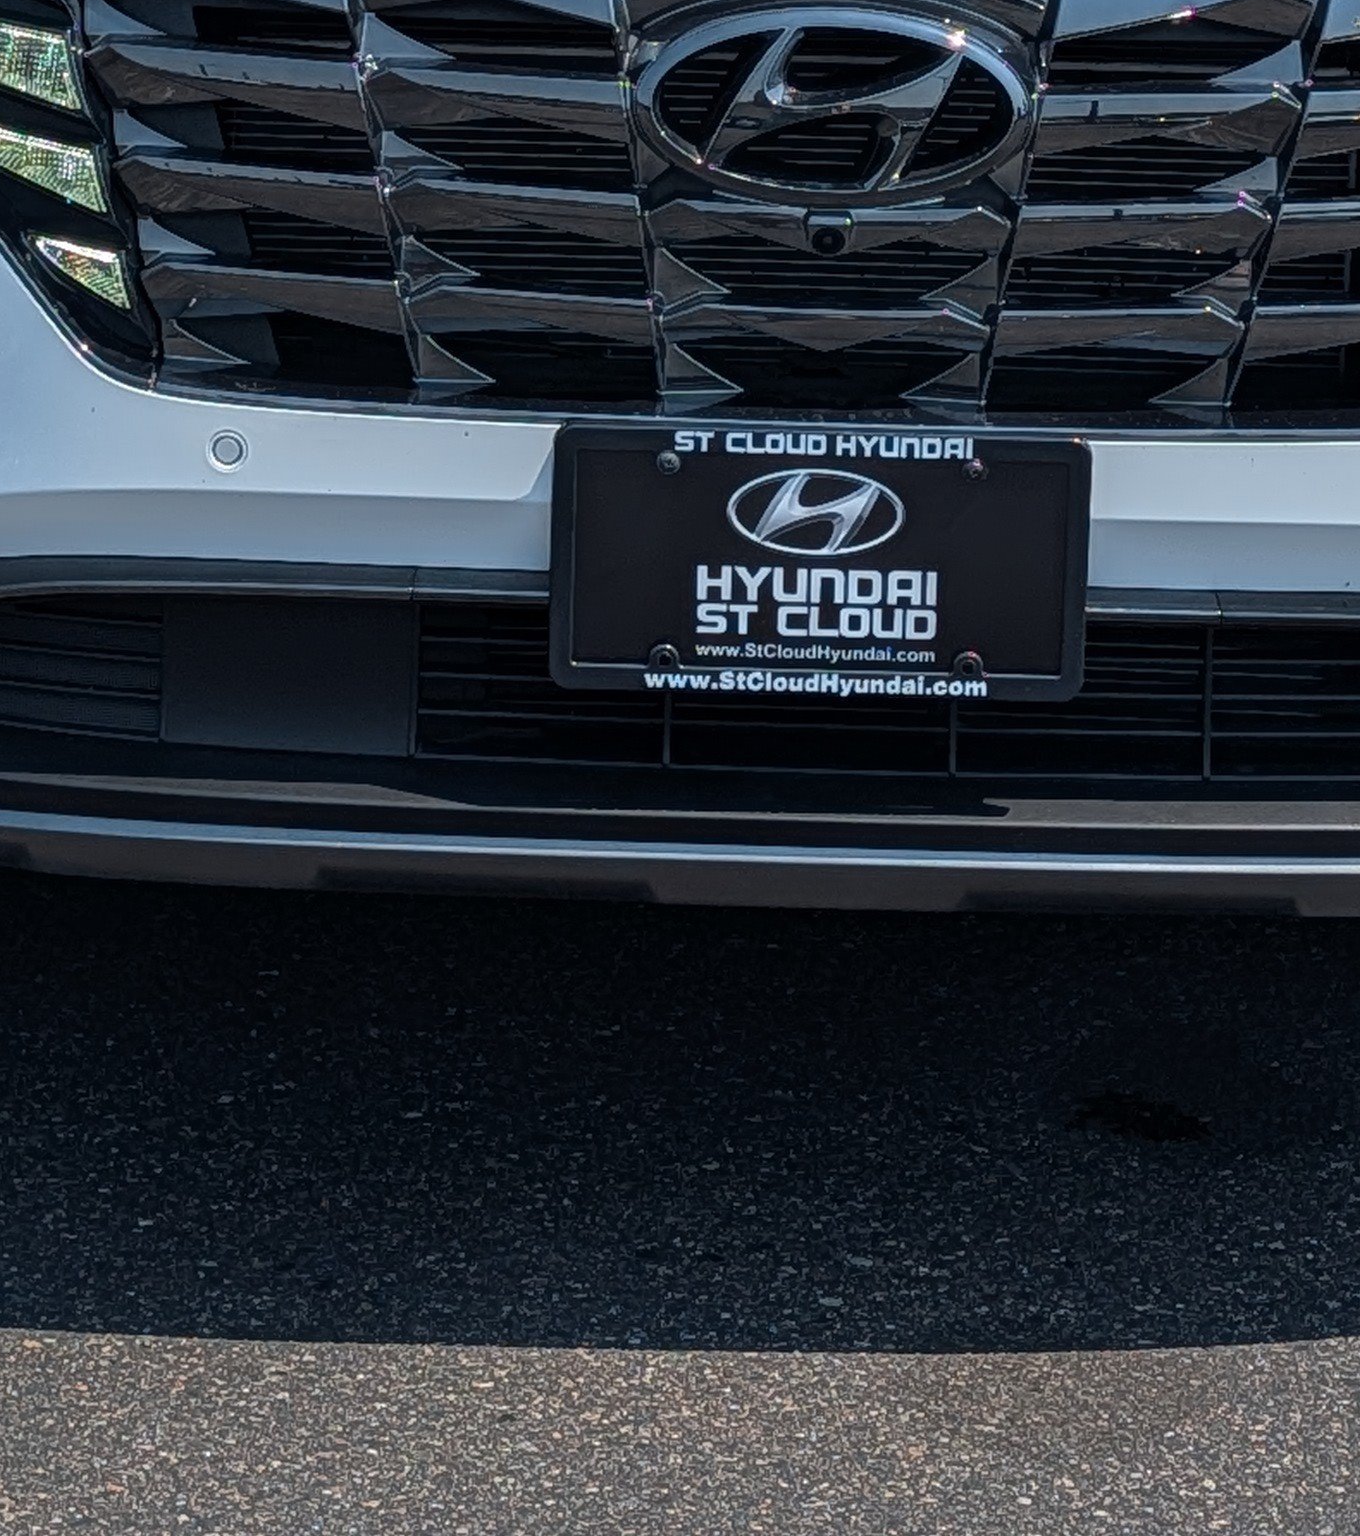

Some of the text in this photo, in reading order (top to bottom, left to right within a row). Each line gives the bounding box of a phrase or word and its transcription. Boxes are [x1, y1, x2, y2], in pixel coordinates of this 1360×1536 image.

[674, 430, 974, 460] ST CLOUD HYUNDAI
[695, 564, 938, 607] HYUNDAI
[695, 604, 938, 641] ST CLOUD
[694, 642, 936, 665] www.StCloudHyundai.com
[643, 671, 989, 699] www.StCloudHyundai.com
